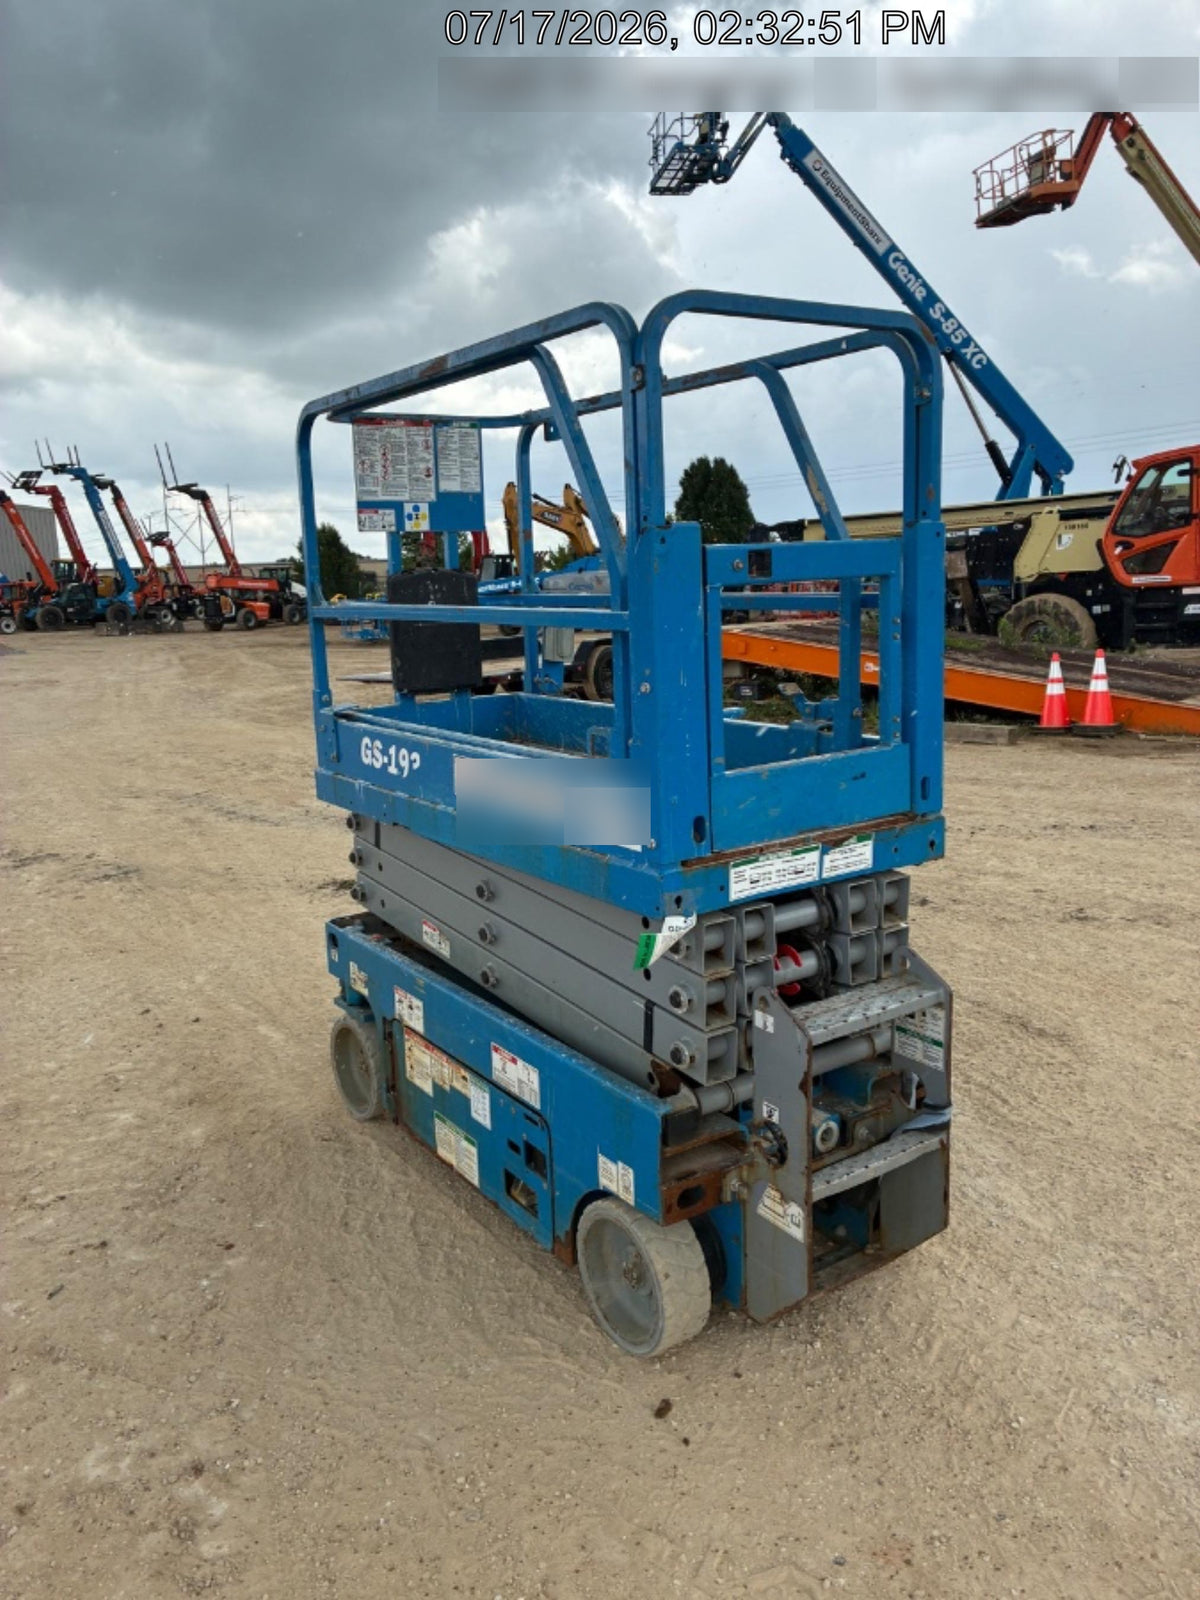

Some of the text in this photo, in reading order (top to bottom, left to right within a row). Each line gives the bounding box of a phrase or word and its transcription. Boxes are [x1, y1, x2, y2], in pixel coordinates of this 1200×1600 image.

[821, 171, 882, 245] EquipmentShare
[889, 253, 988, 369] Genie S-85 XC
